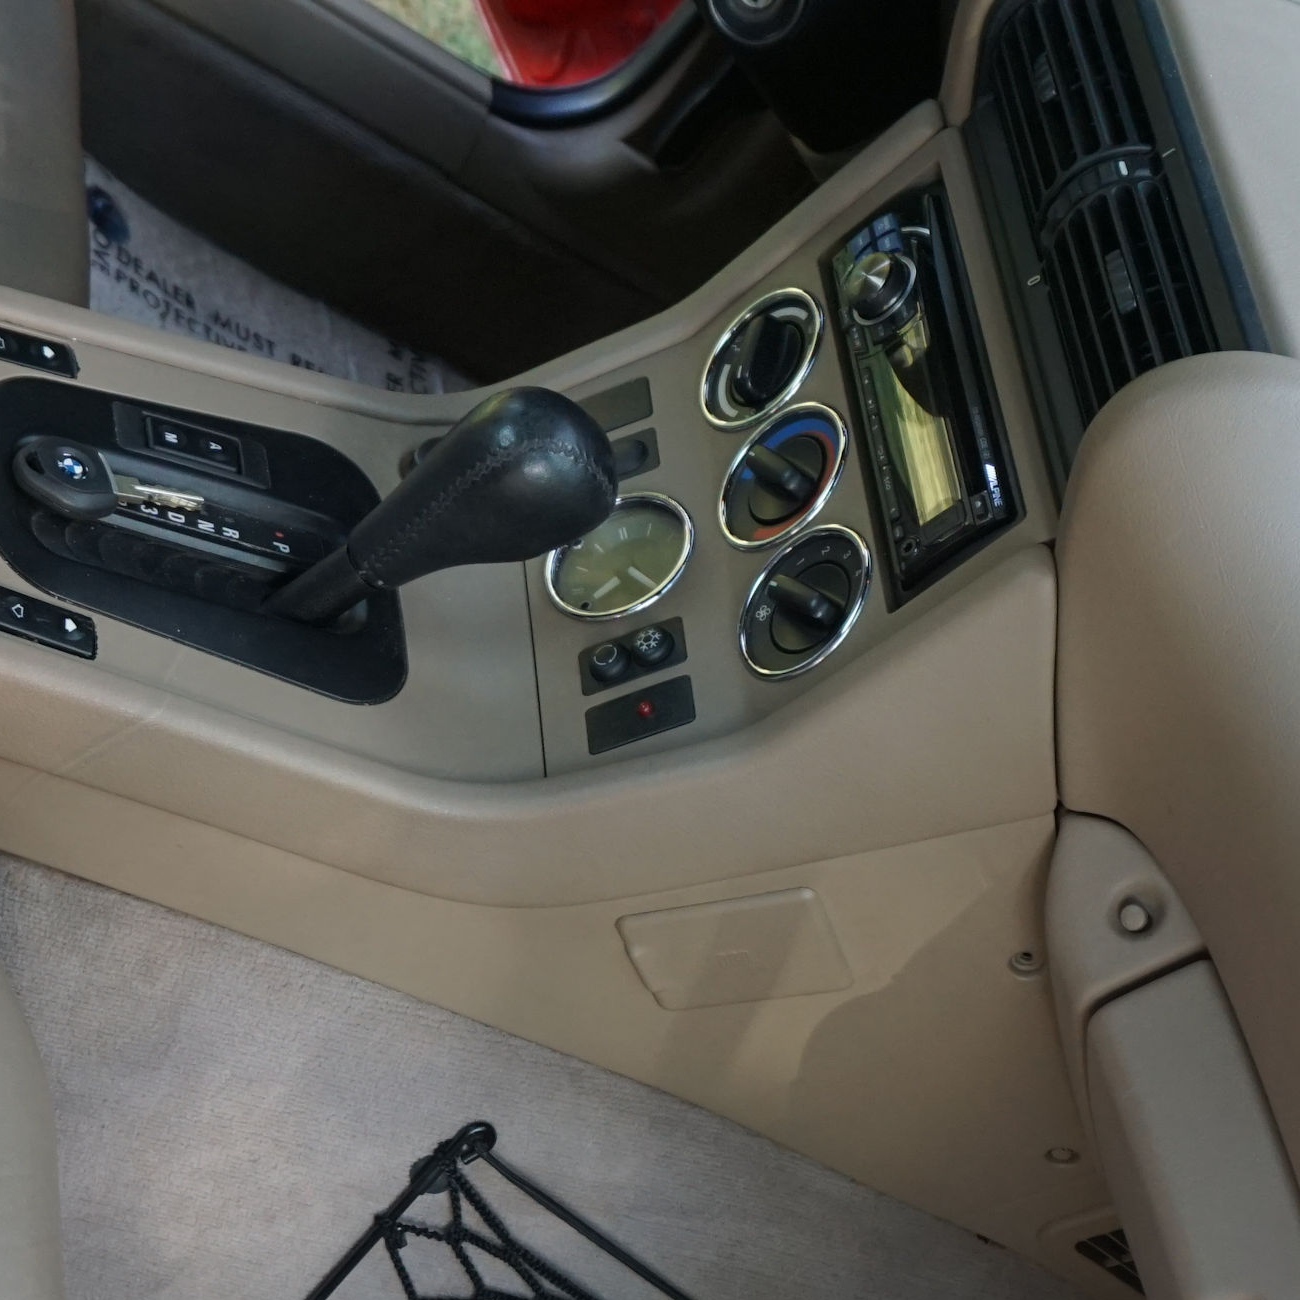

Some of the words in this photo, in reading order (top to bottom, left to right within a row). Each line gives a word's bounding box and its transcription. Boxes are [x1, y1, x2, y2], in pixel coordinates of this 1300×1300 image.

[116, 245, 197, 310] DEALER
[211, 311, 276, 358] MUST
[209, 441, 223, 450] A
[986, 468, 1003, 507] ALPINE
[140, 504, 158, 515] 3
[167, 511, 185, 523] D
[197, 519, 215, 533] N
[222, 527, 240, 539] R
[272, 541, 291, 553] P
